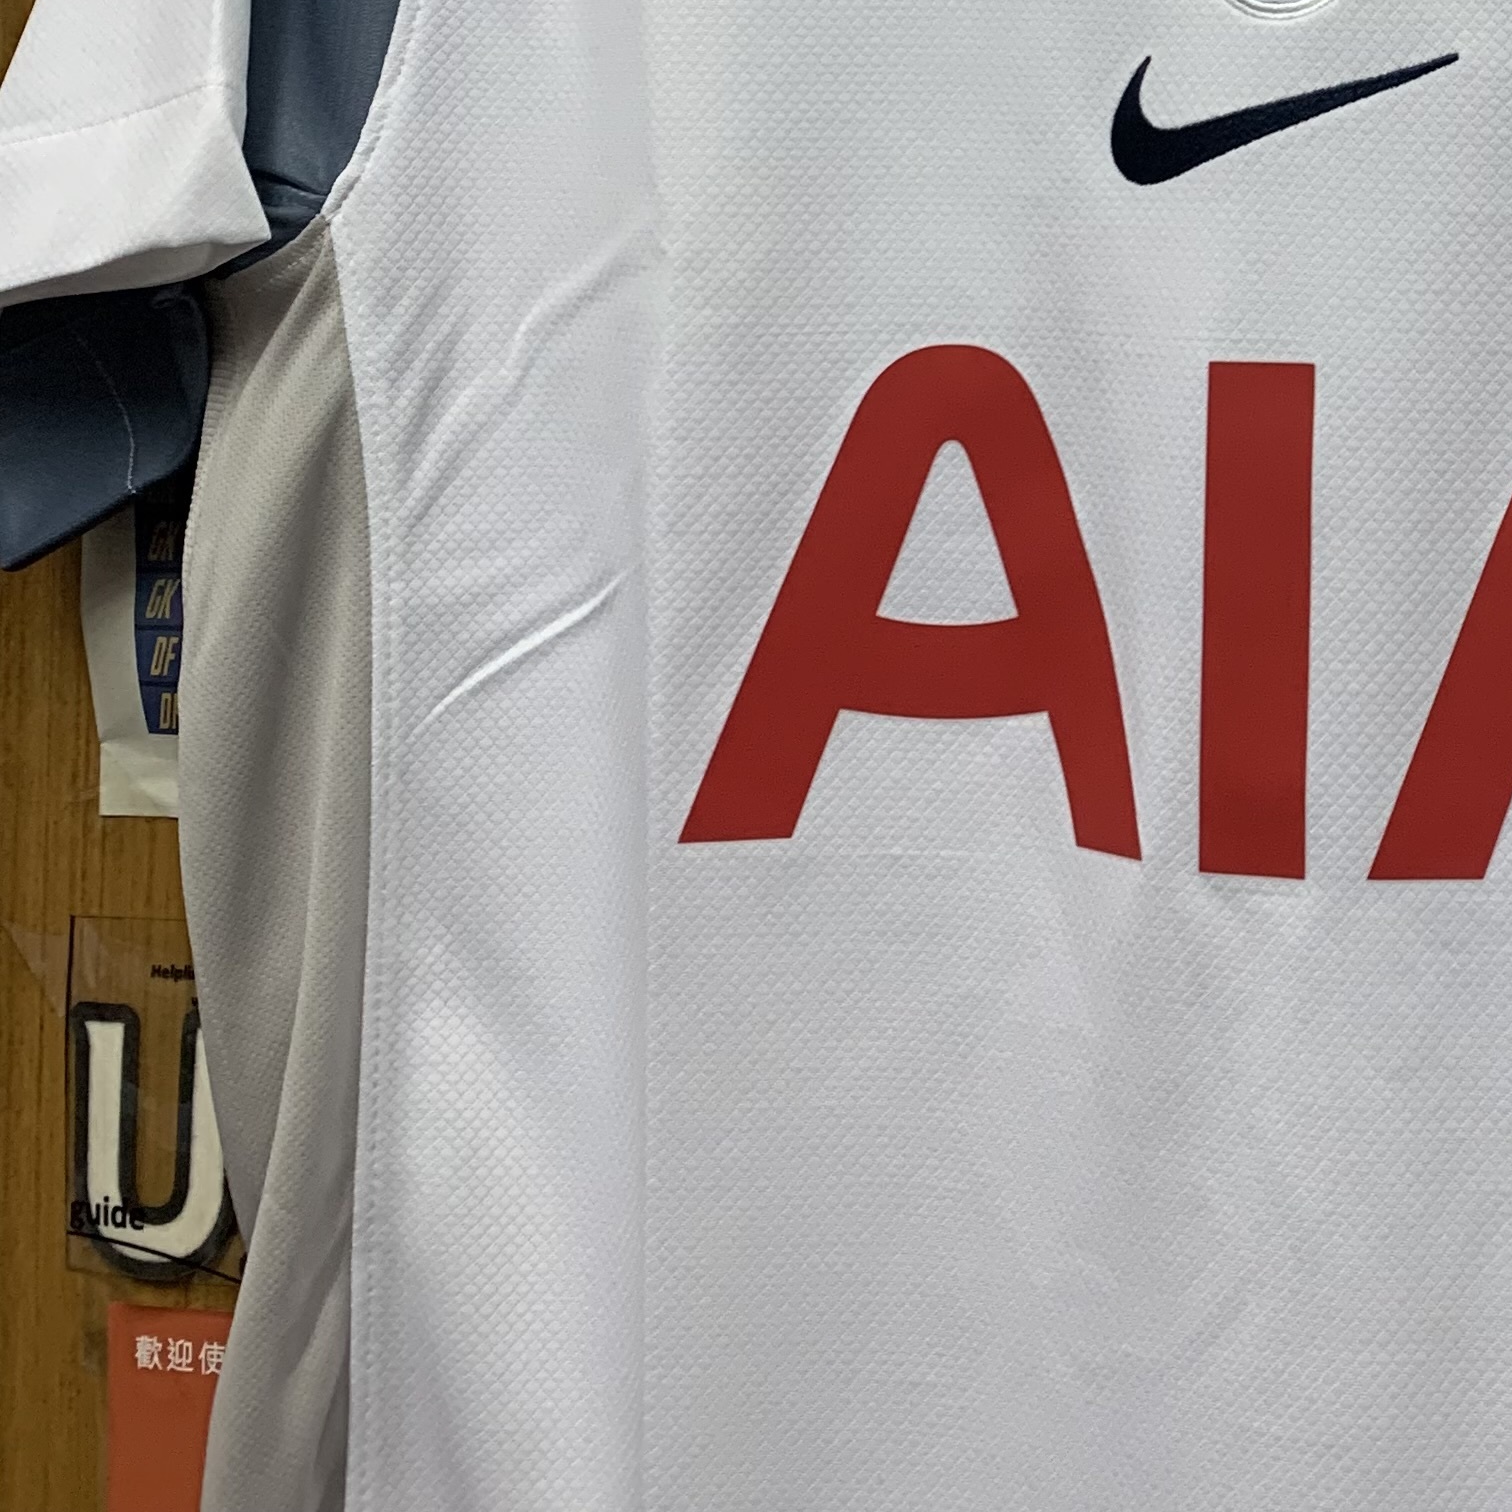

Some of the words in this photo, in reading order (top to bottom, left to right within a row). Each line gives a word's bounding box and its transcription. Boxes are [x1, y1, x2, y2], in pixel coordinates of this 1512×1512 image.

[145, 578, 181, 619] GK
[150, 636, 179, 676] DF
[70, 1196, 146, 1231] guide
